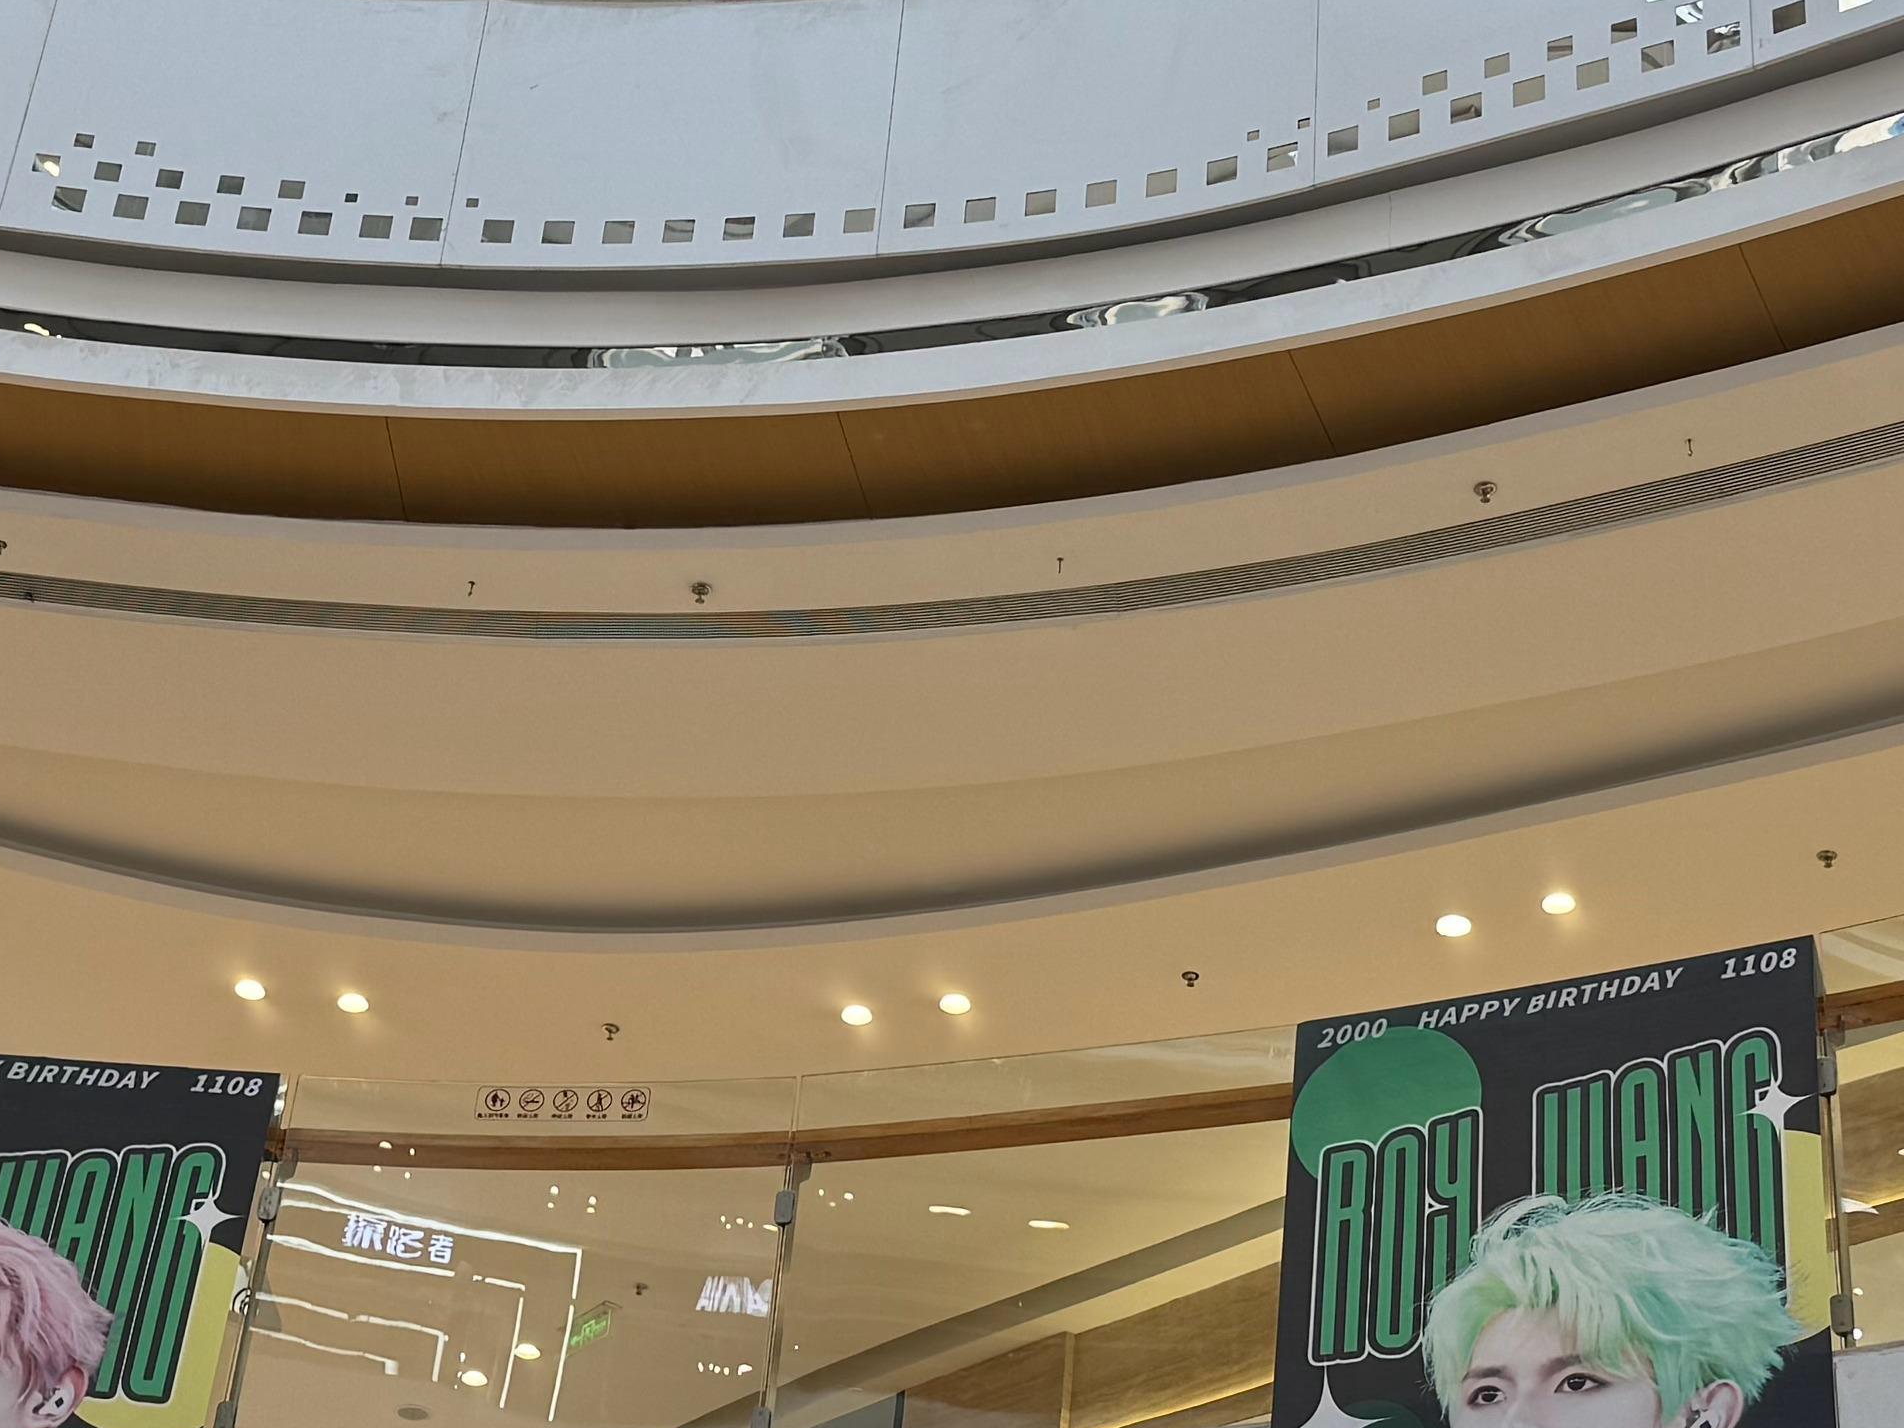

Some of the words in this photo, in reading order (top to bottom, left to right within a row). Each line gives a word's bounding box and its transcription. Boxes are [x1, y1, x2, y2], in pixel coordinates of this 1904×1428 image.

[1316, 1017, 1388, 1050] 2000
[1416, 996, 1519, 1030] HAPPY
[1526, 968, 1684, 1015] BIRTHDAY
[1720, 948, 1797, 980] 1108
[7, 1060, 160, 1091] BIRTHDAY
[189, 1073, 263, 1097] 1108
[342, 1212, 456, 1264] 探路者
